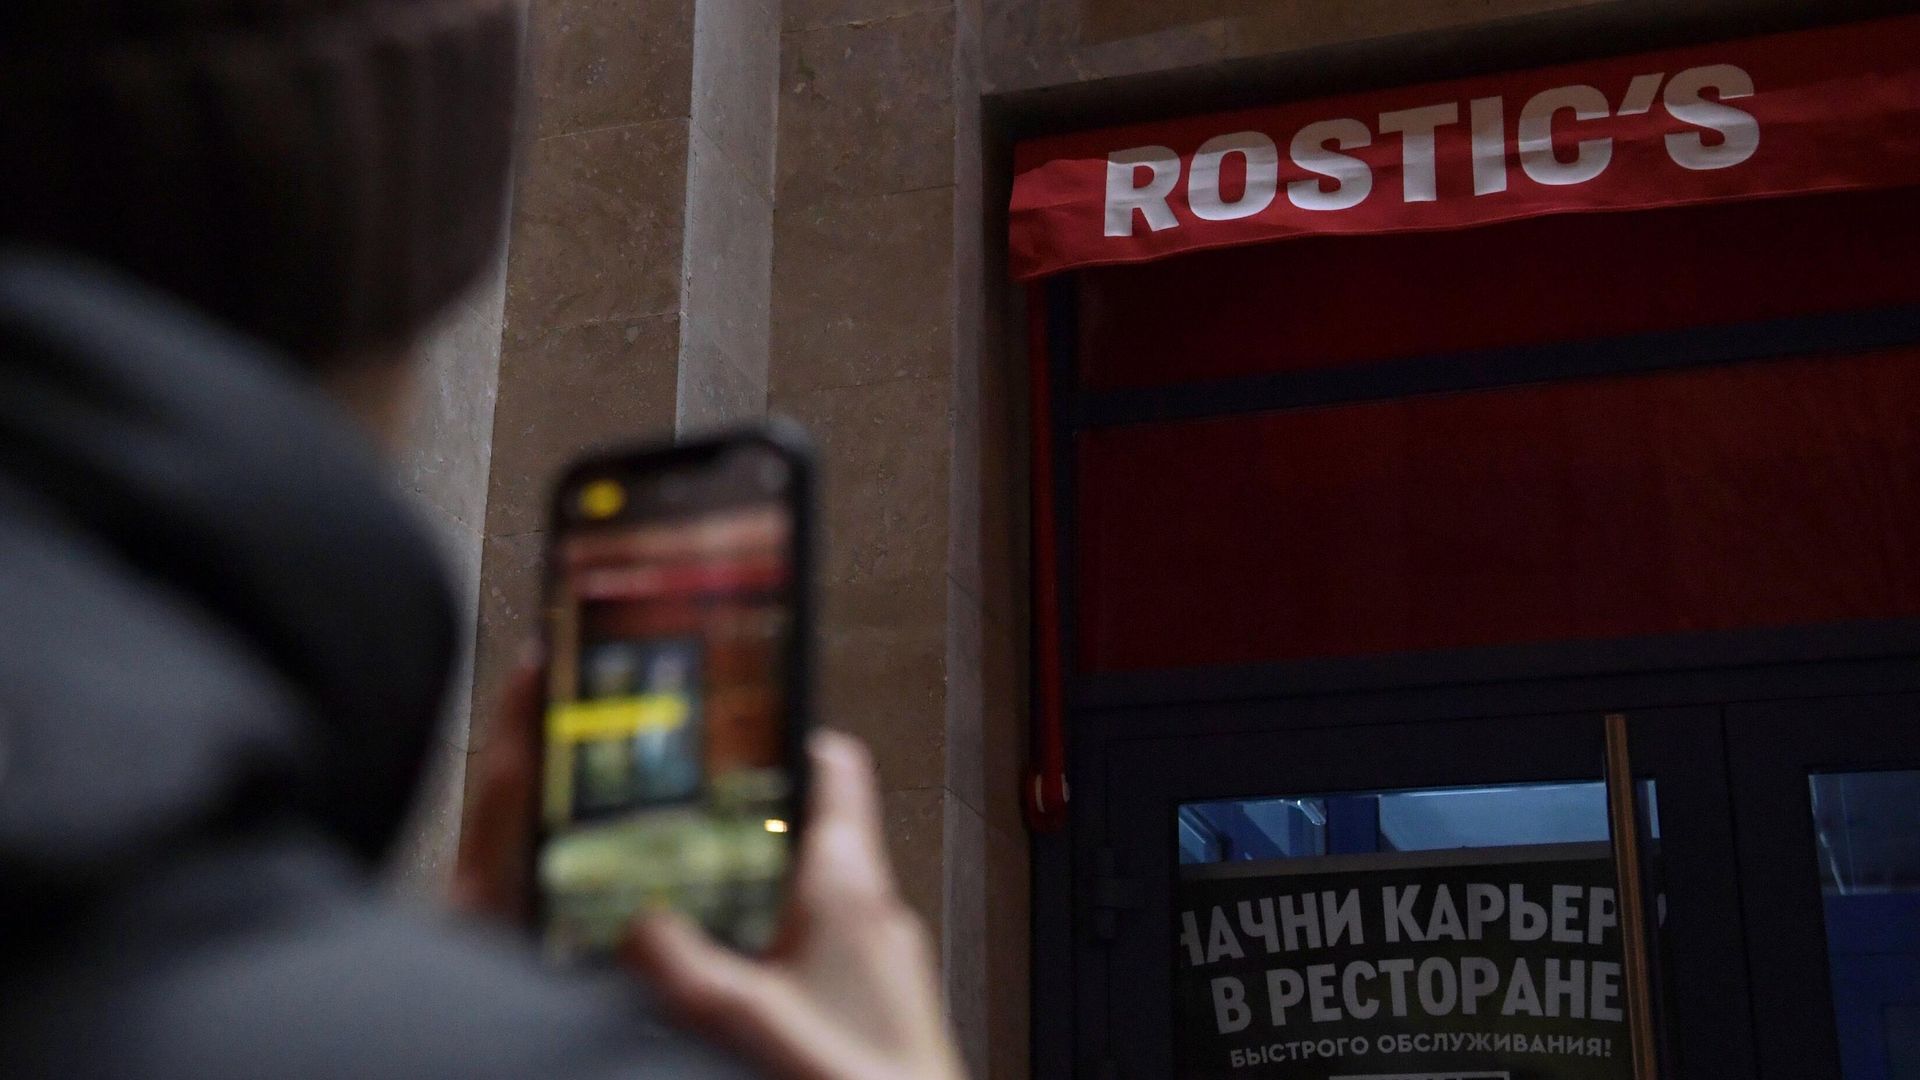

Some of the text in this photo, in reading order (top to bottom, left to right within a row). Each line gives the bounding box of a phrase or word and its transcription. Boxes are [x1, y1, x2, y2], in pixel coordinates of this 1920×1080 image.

[1103, 63, 1760, 238] ROSTIC'S
[1381, 882, 1667, 946] КАРЬЕР
[1210, 956, 1623, 1034] В РЕСТОРАНЕ
[1229, 1031, 1612, 1068] БЫСТРОГО ОБСЛУЖИВАНИЯ!
